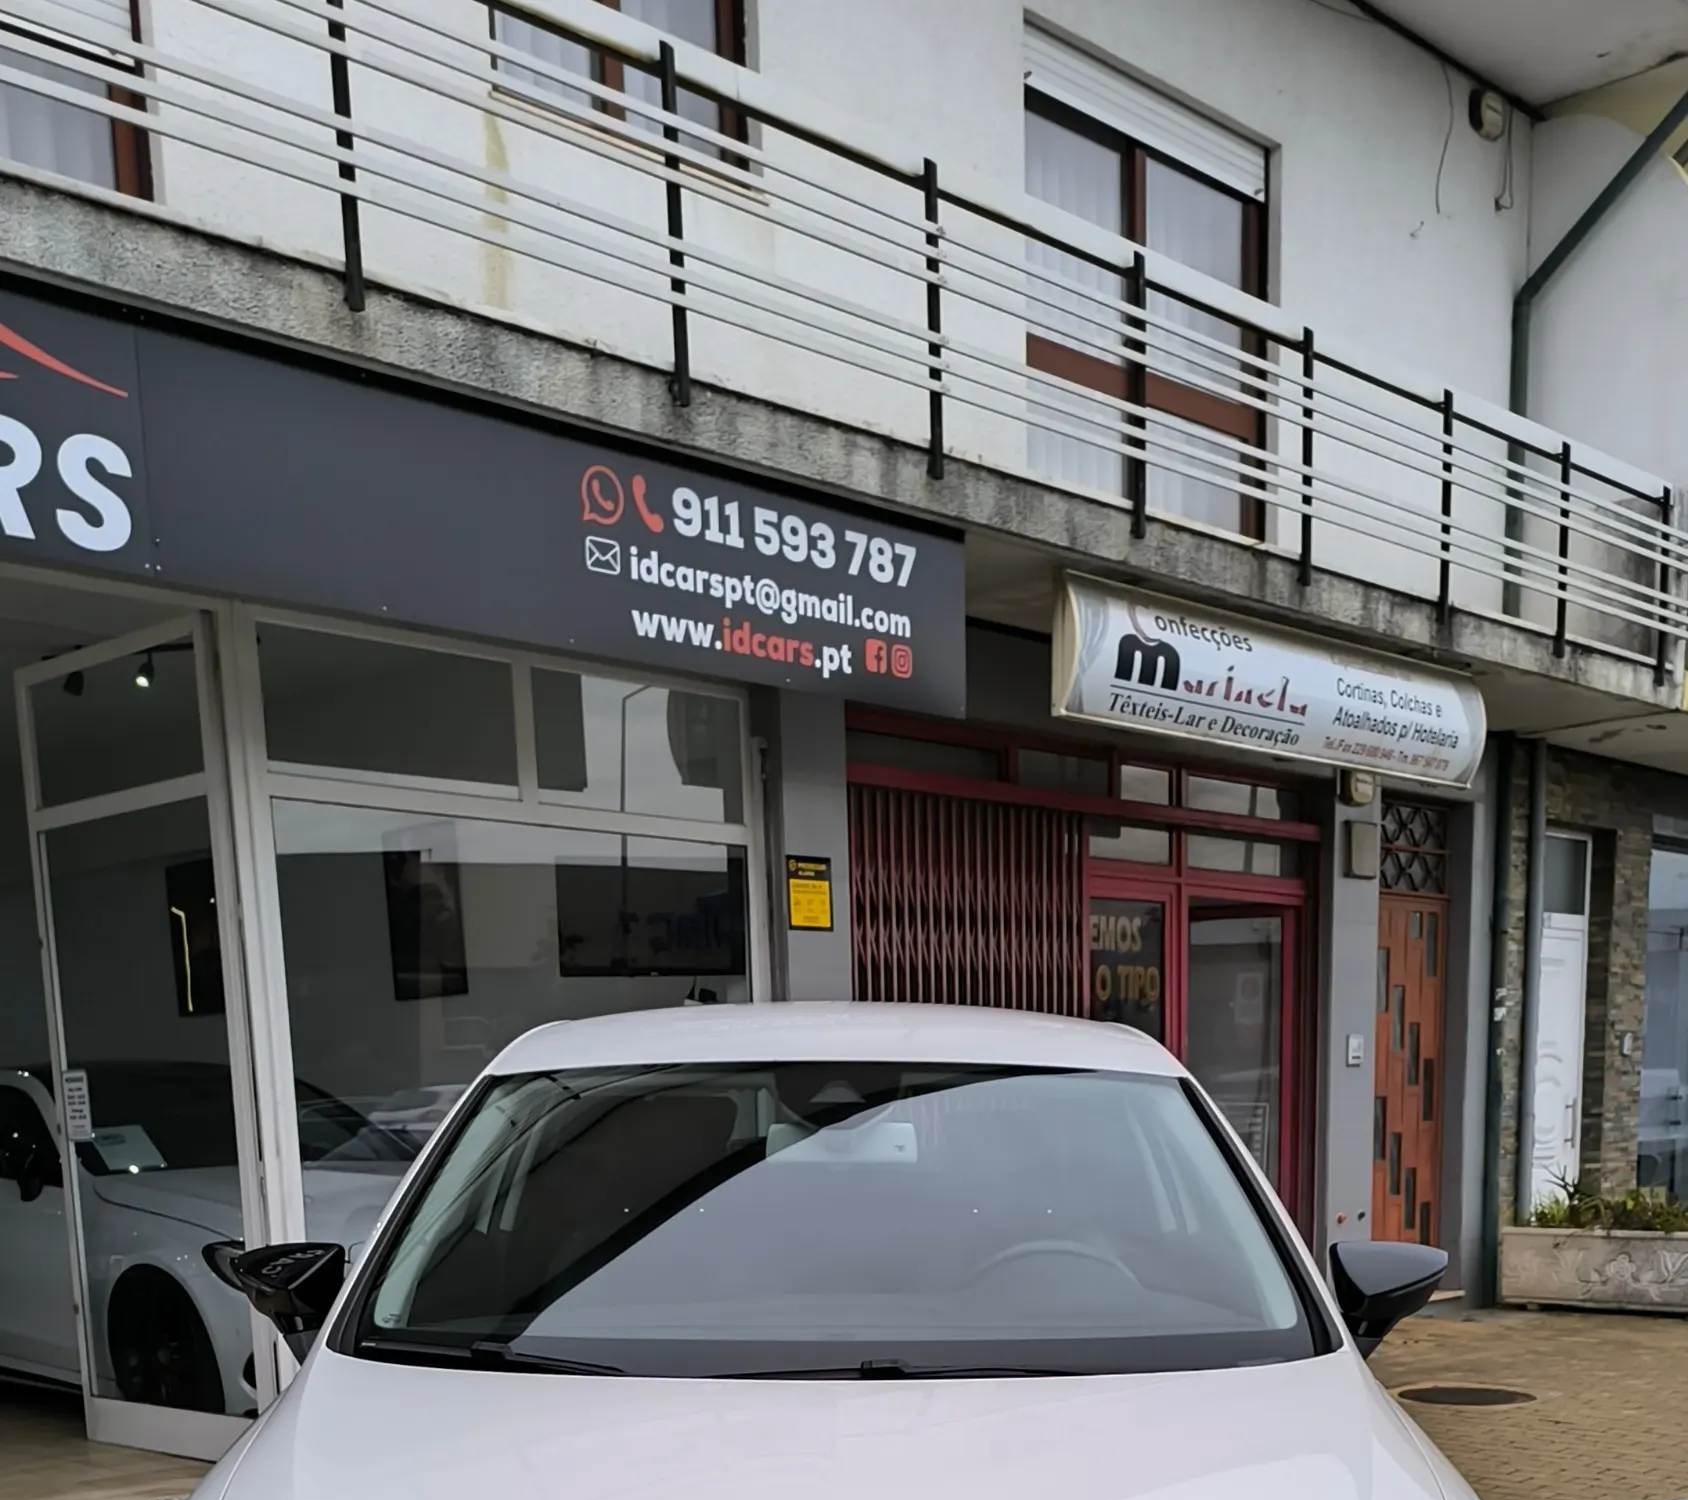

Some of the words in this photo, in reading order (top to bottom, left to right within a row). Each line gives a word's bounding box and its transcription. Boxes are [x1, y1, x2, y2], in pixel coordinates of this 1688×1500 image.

[672, 486, 745, 549] 911
[754, 506, 837, 570] 593
[844, 529, 917, 588] 787
[629, 545, 912, 638] idcarspt@gmail.com
[631, 608, 853, 679] www.idcars.pt
[1108, 692, 1207, 729] Têxteis-Lar
[1207, 717, 1218, 732] e
[1219, 715, 1301, 748] Decoração
[1332, 706, 1398, 738] Atoalhados
[1411, 721, 1459, 749] Hotelaria
[1336, 677, 1387, 709] Cortinas,
[1390, 689, 1433, 716] Colchas
[1435, 704, 1443, 718] e
